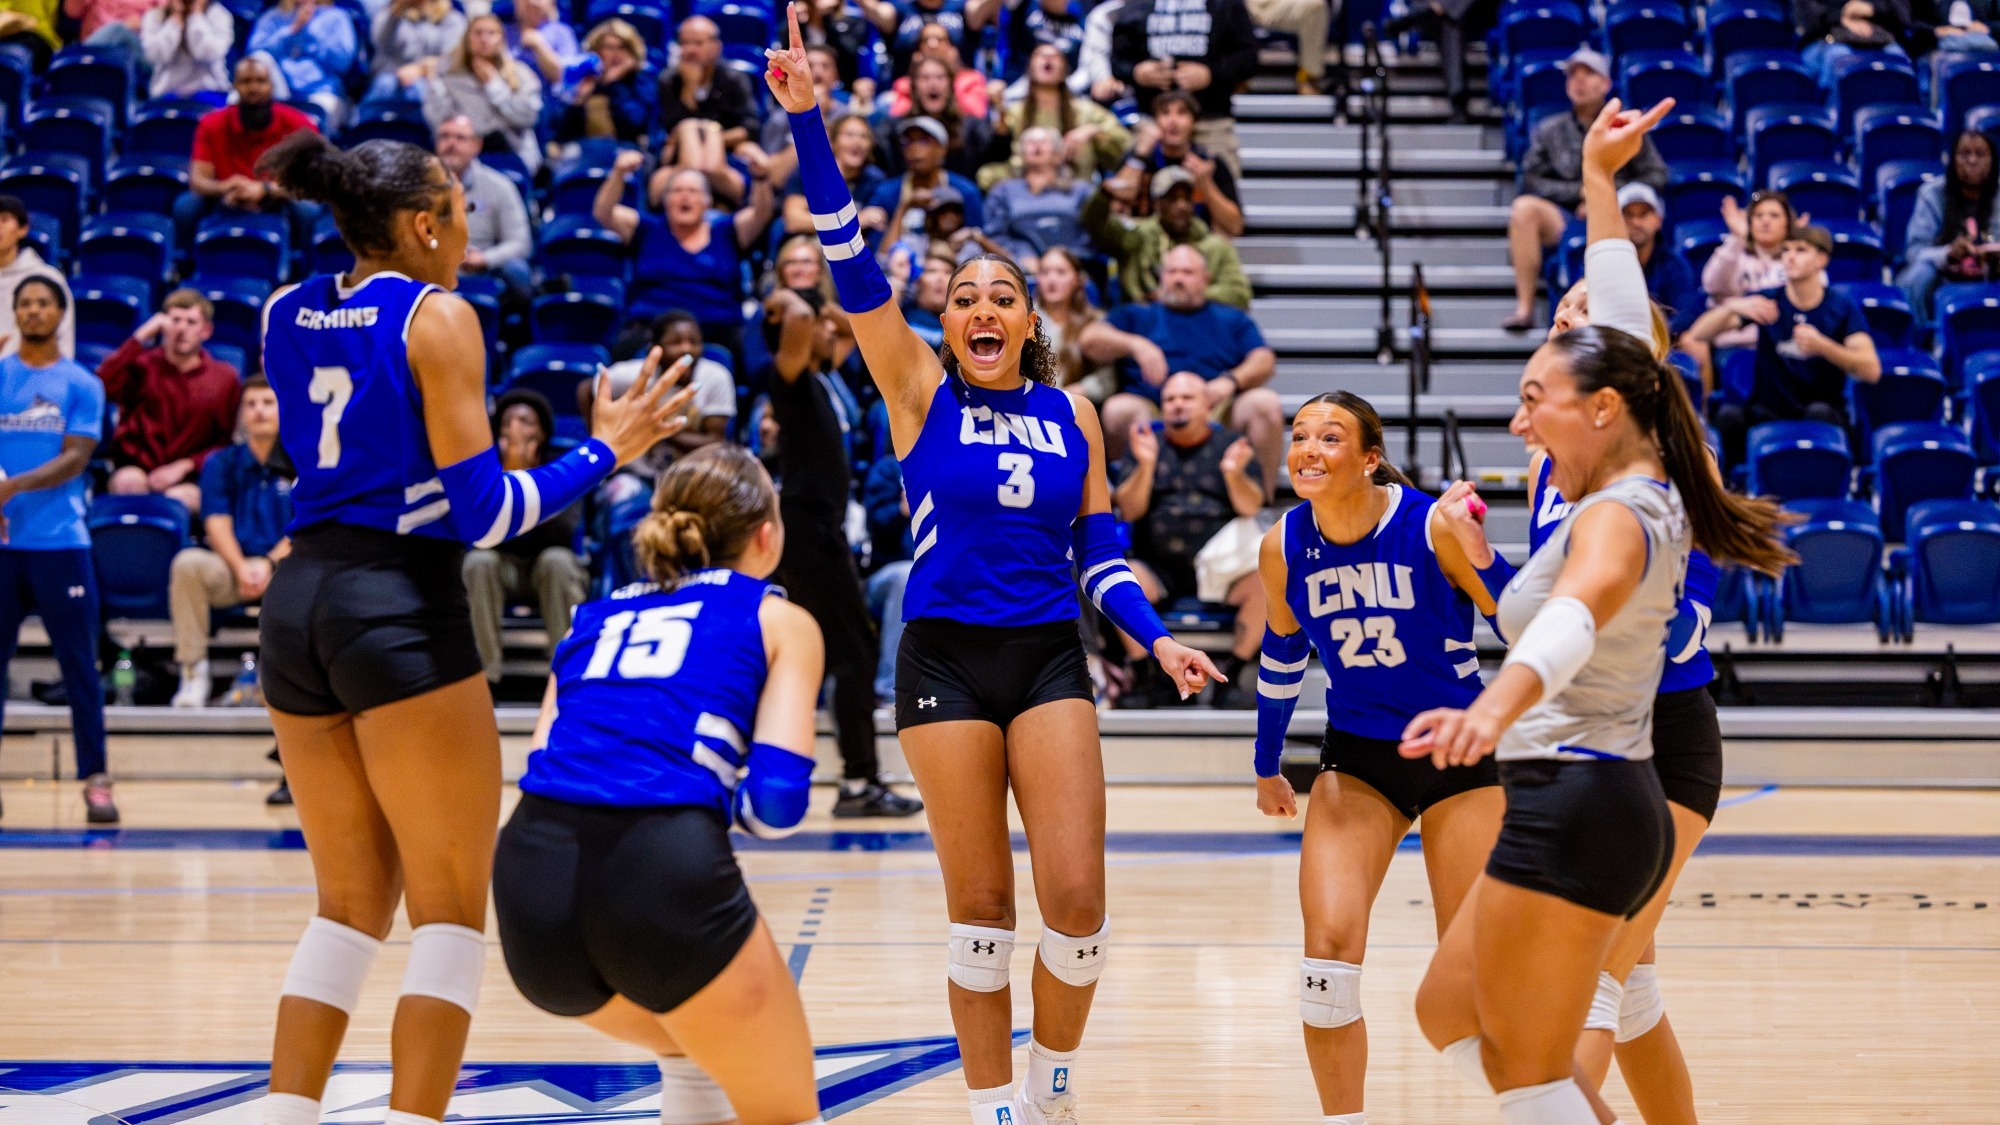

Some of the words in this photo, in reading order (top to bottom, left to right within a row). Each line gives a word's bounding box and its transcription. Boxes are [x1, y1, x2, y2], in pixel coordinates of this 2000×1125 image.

[308, 365, 354, 469] 7
[959, 404, 1068, 458] CNU
[997, 451, 1036, 509] 3
[1304, 561, 1416, 618] CNU
[581, 600, 704, 680] 15
[1329, 614, 1407, 669] 23
